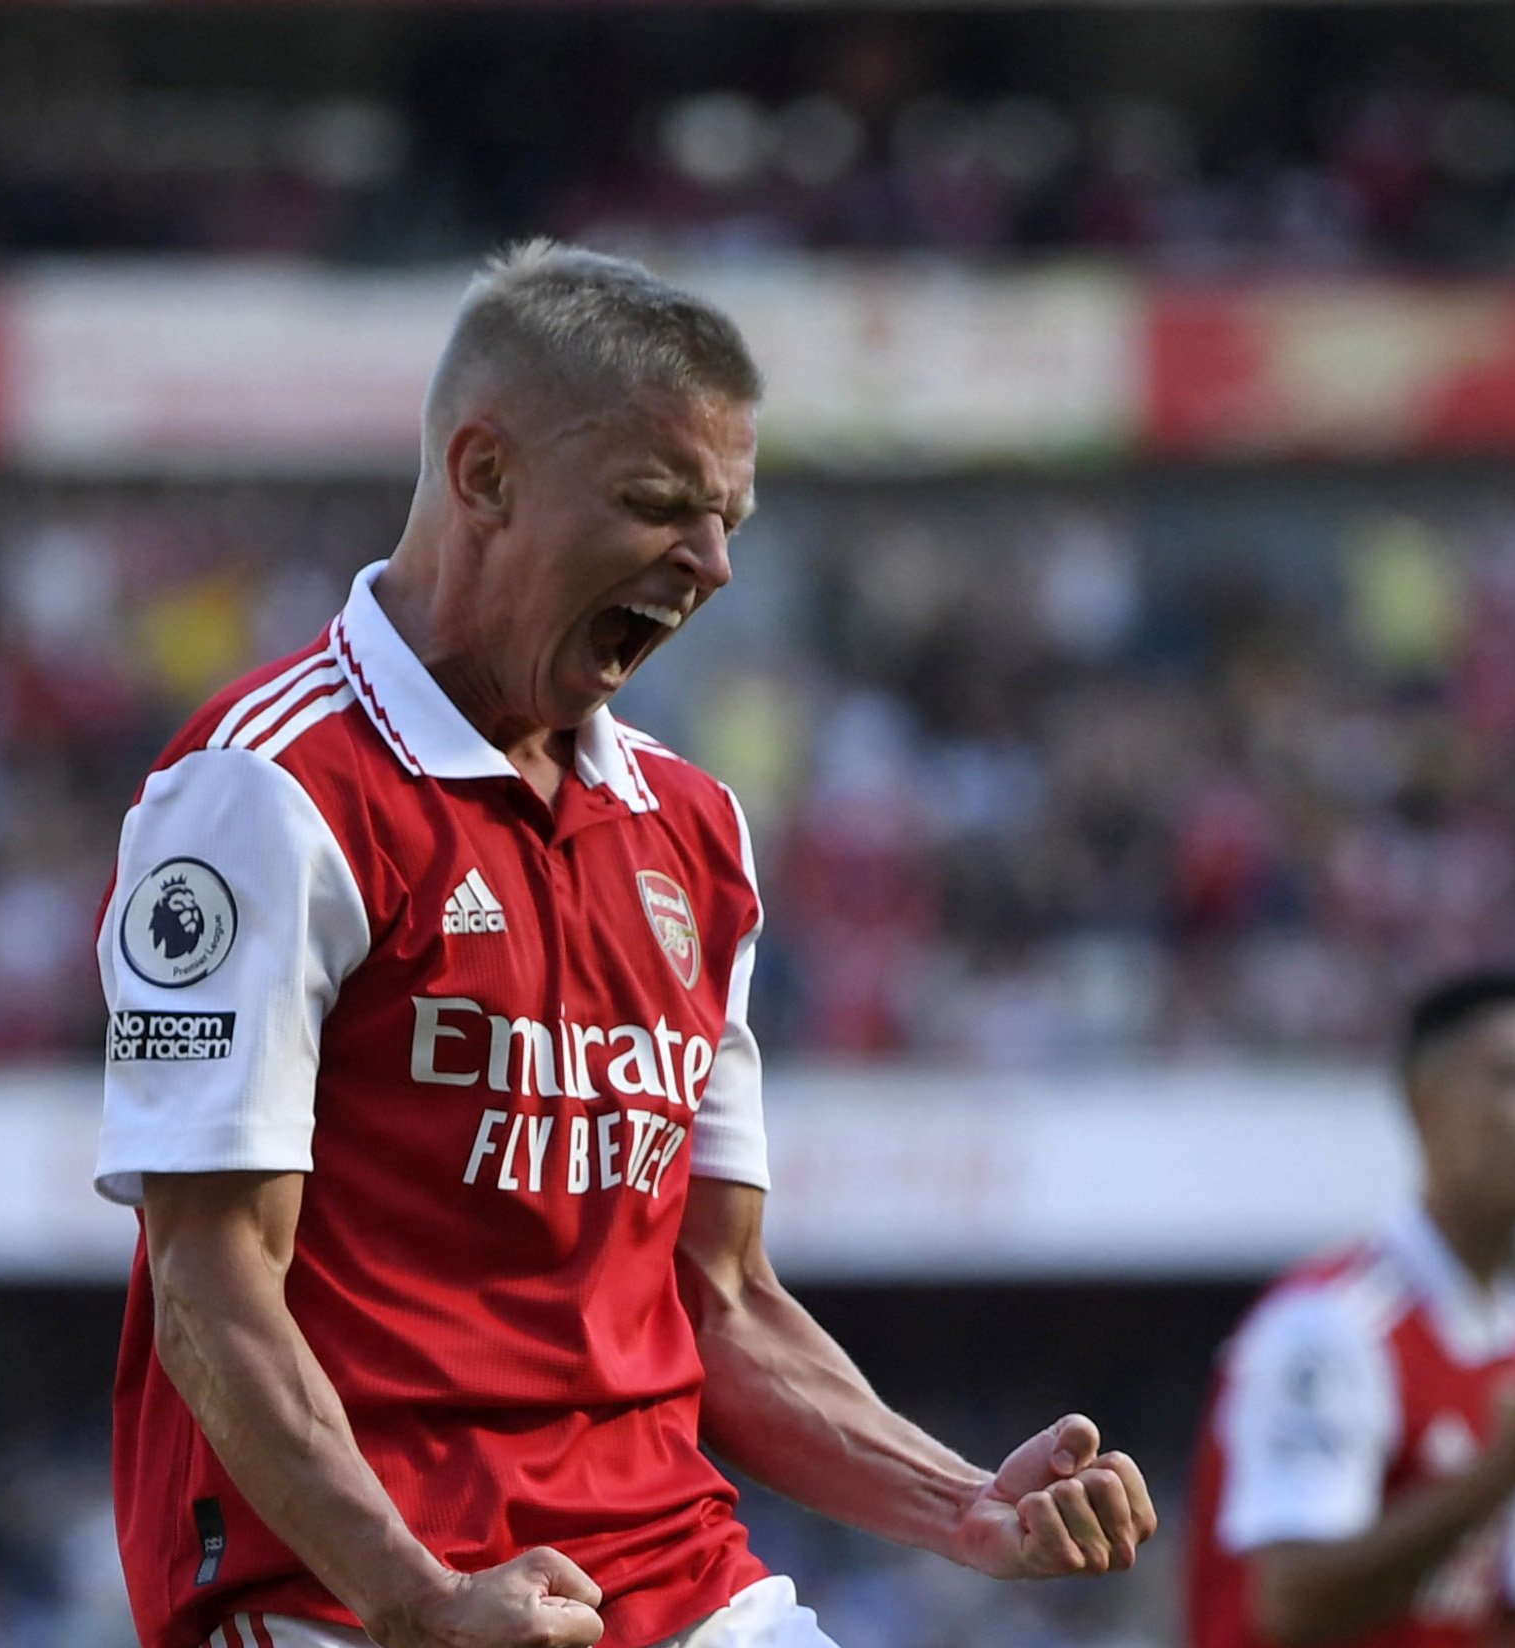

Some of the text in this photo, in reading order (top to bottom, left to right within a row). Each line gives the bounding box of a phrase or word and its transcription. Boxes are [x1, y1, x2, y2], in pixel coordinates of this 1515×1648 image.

[442, 908, 506, 934] adida
[172, 913, 225, 976] Premier League
[110, 1011, 223, 1038] No room
[146, 1037, 231, 1059] racism
[411, 996, 714, 1112] Emirate
[462, 1108, 554, 1193] FLY
[567, 1108, 687, 1199] BETTER
